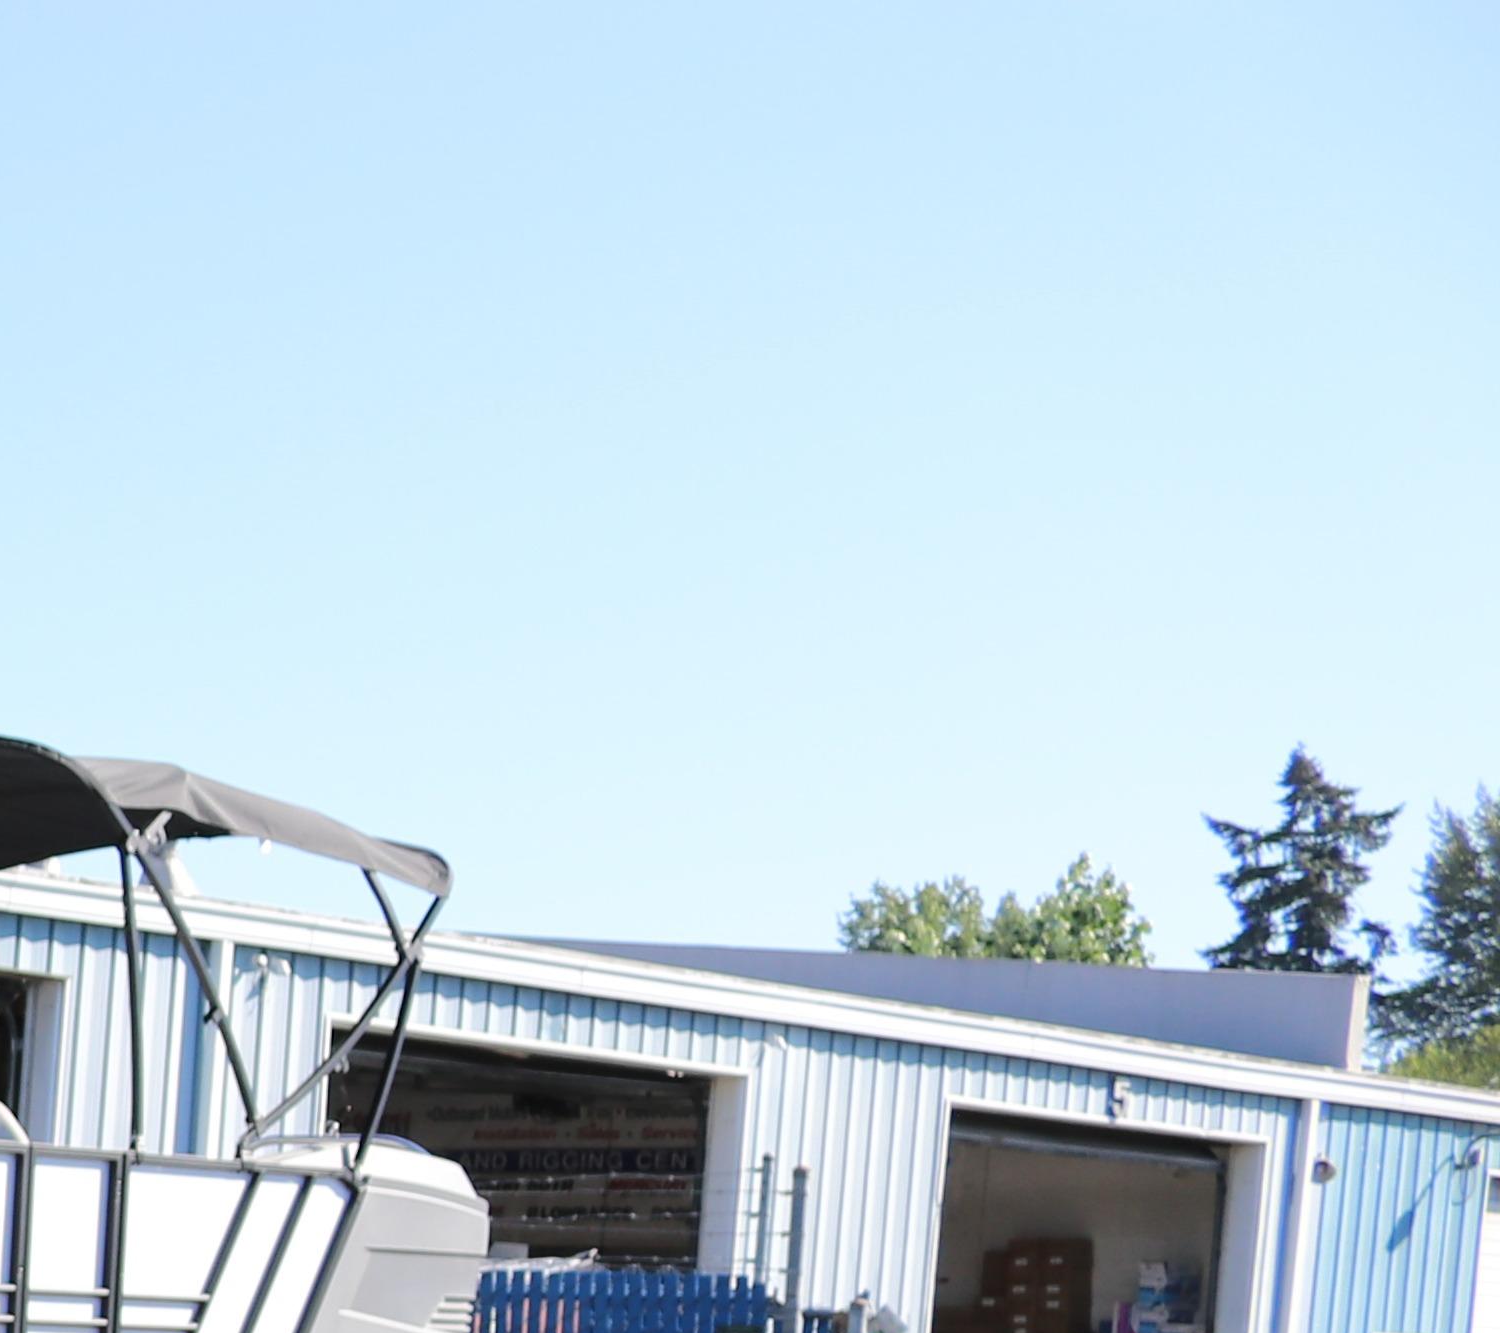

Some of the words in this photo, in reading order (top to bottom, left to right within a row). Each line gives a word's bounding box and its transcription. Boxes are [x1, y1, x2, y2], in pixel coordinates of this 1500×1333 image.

[1112, 1075, 1133, 1119] 5
[460, 1151, 507, 1169] AND
[519, 1151, 623, 1169] RIGGING
